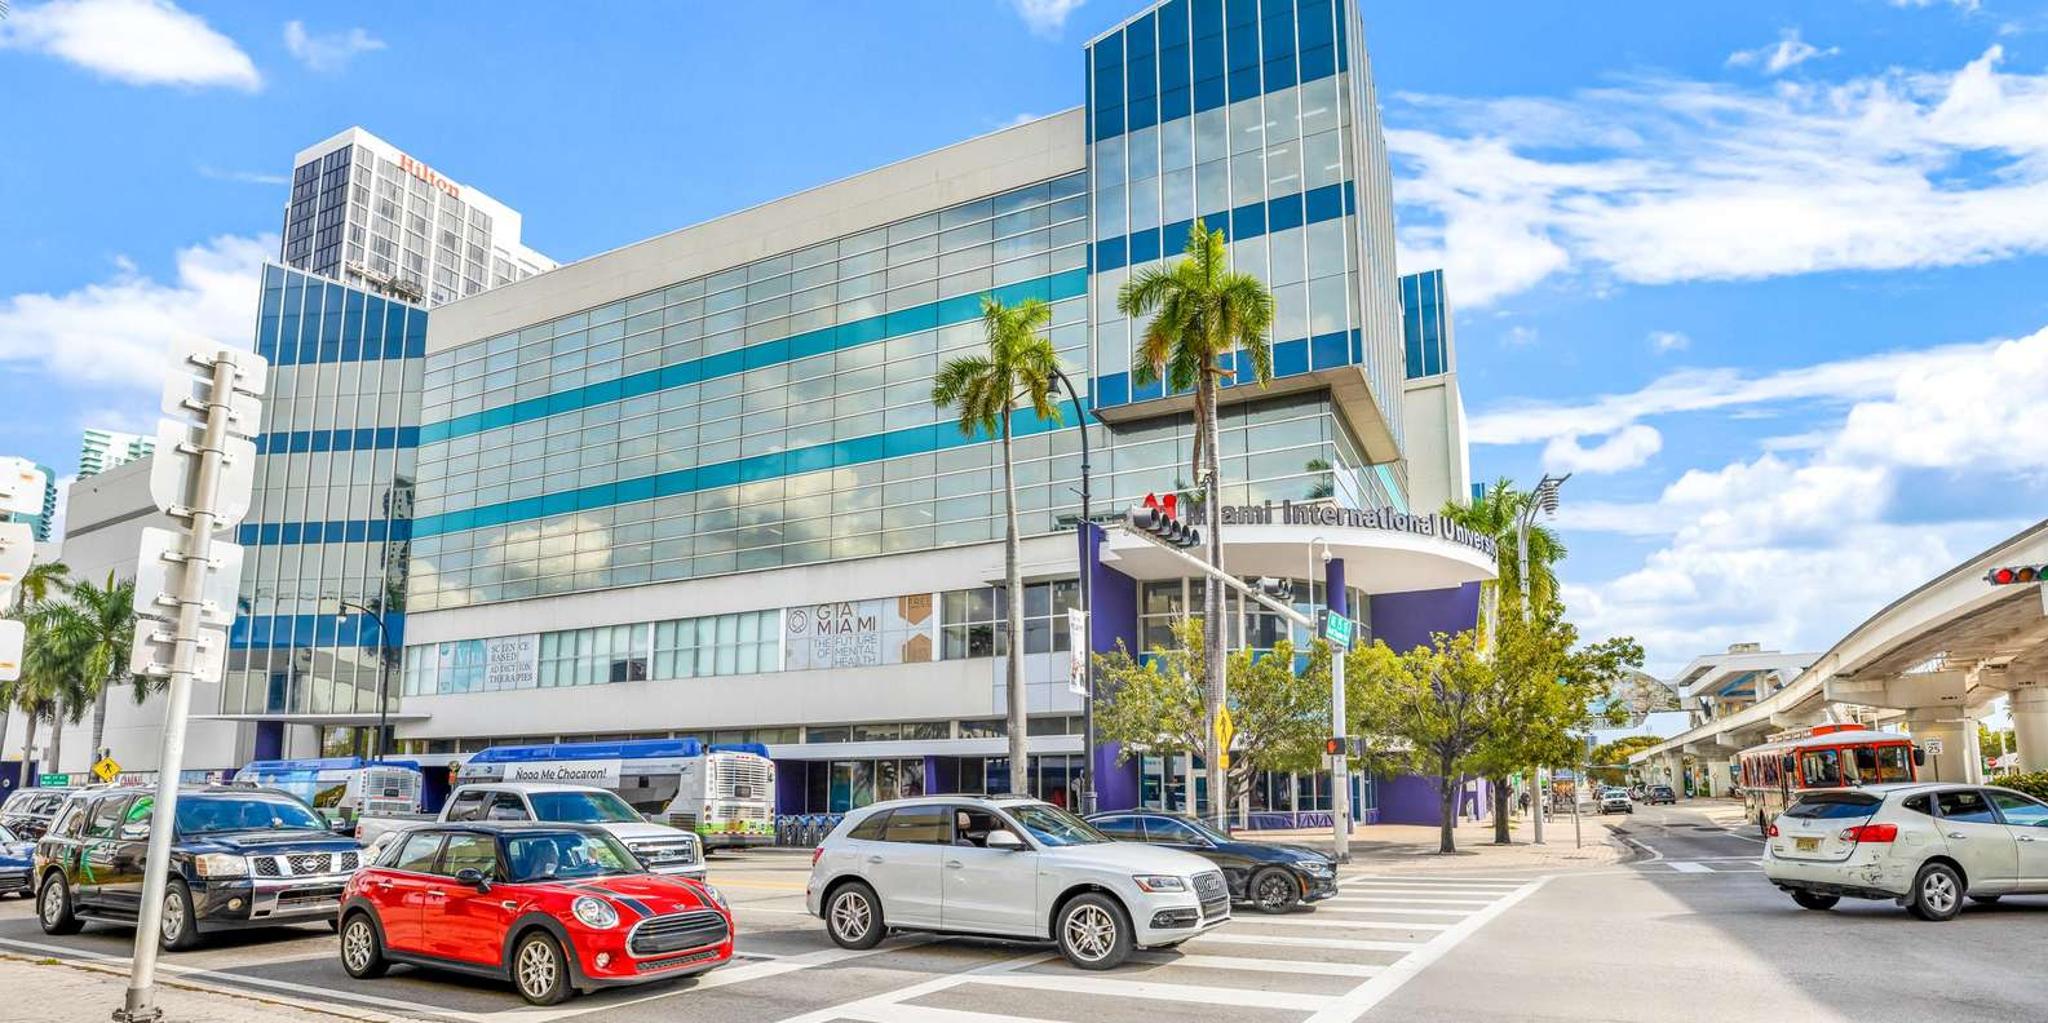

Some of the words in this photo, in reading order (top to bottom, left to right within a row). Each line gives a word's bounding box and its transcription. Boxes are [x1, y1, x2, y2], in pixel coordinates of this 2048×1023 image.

[401, 154, 459, 199] Hilton
[1186, 500, 1272, 525] Mami
[1283, 500, 1436, 536] International
[817, 616, 876, 635] MIAMI
[491, 642, 530, 652] SCIENCE
[489, 672, 533, 683] THERAPIES
[1928, 746, 1940, 754] 25
[541, 769, 555, 779] Me
